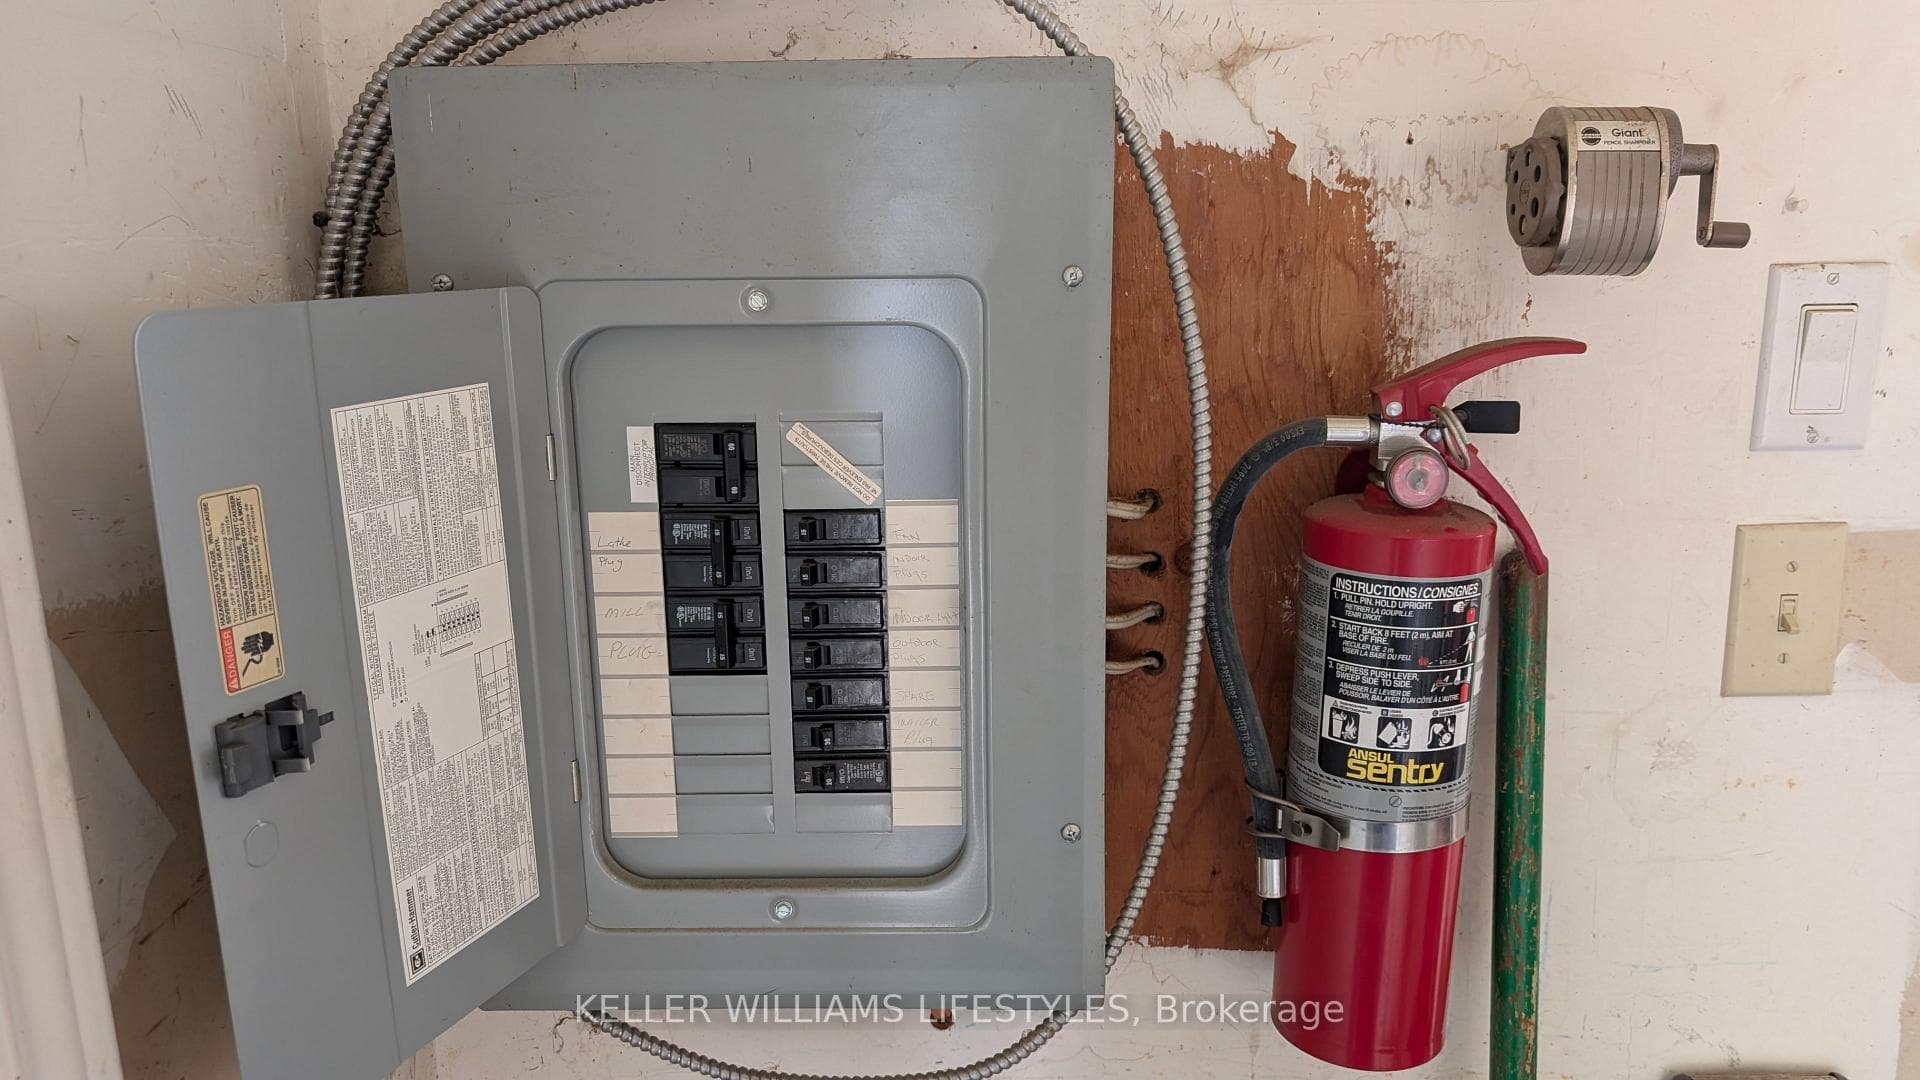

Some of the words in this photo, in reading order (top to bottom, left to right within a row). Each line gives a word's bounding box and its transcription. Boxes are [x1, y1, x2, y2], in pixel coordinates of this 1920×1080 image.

[1612, 128, 1643, 138] Giant
[728, 442, 736, 451] 60
[634, 442, 642, 485] DISCONNECT
[833, 469, 853, 487] REMOVE
[730, 486, 738, 494] 60
[852, 484, 863, 495] NOT
[202, 501, 211, 526] CAUSE
[229, 494, 238, 522] CAUSER
[235, 495, 243, 516] MORT.
[238, 516, 244, 526] LA
[240, 526, 246, 536] OU
[214, 536, 222, 561] DEATH.
[241, 536, 250, 564] GRAVES
[597, 536, 632, 548] Lathe
[209, 548, 219, 581] VOLTAGE.
[218, 561, 224, 572] OR
[236, 543, 248, 589] DANGEREUSE.
[599, 556, 623, 572] Plug
[219, 573, 227, 597] INJURY
[245, 564, 255, 602] BLESSURES
[214, 582, 225, 626] HAZARDOUS
[242, 589, 251, 618] TENSION
[1334, 591, 1339, 599] 1.
[1341, 593, 1358, 604] PULL
[1360, 597, 1374, 606] PIN.
[1375, 600, 1397, 608] HOLD
[1398, 601, 1433, 610] UPRIGHT.
[1344, 603, 1370, 613] RETIRER
[223, 597, 231, 624] SEVERE
[604, 607, 643, 618] MILL
[1344, 610, 1362, 619] TENIR
[1331, 620, 1336, 628] 2.
[1339, 622, 1360, 633] START
[1362, 626, 1383, 637] BACK
[1391, 630, 1411, 638] FEET
[1411, 631, 1419, 640] (2
[1432, 631, 1444, 639] AIM
[1339, 630, 1357, 640] BASE
[1359, 634, 1370, 642] OF
[1370, 636, 1389, 645] FIRE.
[222, 629, 237, 677] DANGER
[1342, 640, 1370, 650] RECULER
[1342, 646, 1359, 655] VISER
[1369, 651, 1386, 659] BASE
[805, 656, 811, 664] 15
[1336, 662, 1369, 676] DEPRESS
[1370, 670, 1392, 678] PUSH
[1393, 672, 1419, 681] LEVER,
[1336, 671, 1360, 682] SWEEP
[1362, 676, 1379, 685] SIDE
[1382, 679, 1392, 687] TO
[1393, 680, 1412, 688] SIDE.
[1339, 682, 1369, 693] ABAISSER
[1379, 688, 1401, 696] LEVIER
[1339, 688, 1370, 700] POUSSOIR,
[1371, 694, 1400, 703] BALAYER
[1220, 664, 1237, 701] PRESSURE
[1232, 706, 1248, 733] TESTED
[1348, 748, 1394, 764] ANSUL
[1346, 758, 1444, 785] Sentry
[826, 778, 832, 786] 20
[403, 885, 420, 950] Cutler-Hammer
